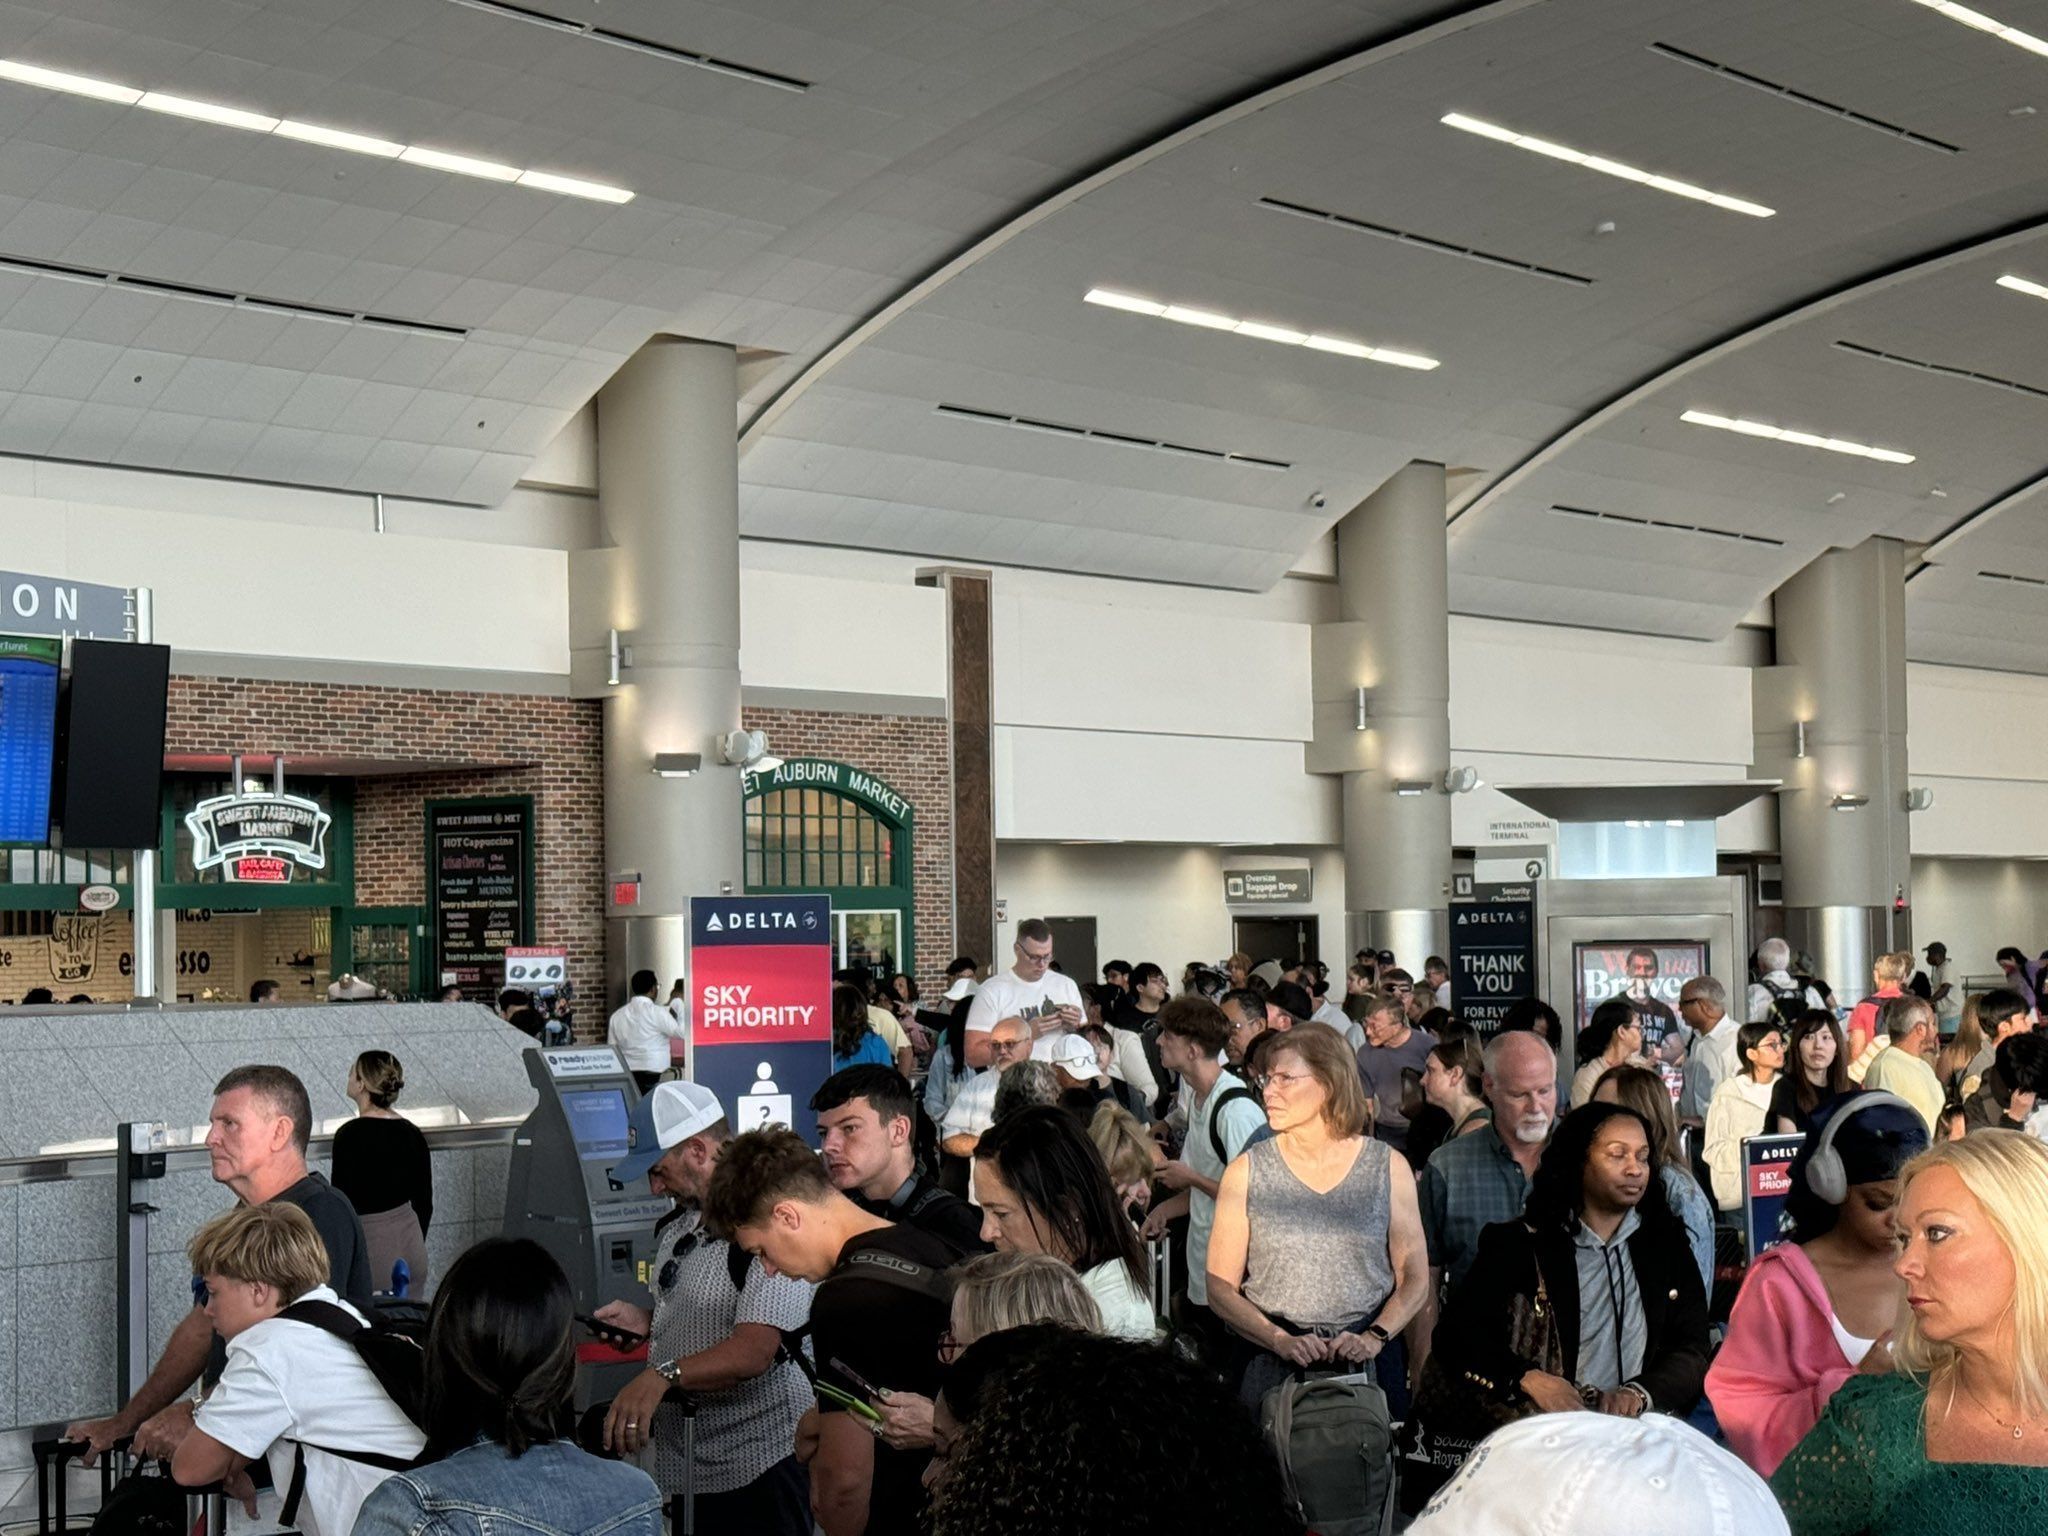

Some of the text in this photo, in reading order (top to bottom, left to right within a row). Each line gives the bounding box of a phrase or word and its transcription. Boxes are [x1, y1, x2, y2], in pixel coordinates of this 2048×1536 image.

[0, 583, 77, 621] ON
[0, 641, 28, 652] rtures
[773, 762, 838, 784] AUBURN
[848, 771, 910, 819] MARKET
[463, 814, 493, 825] AUBURN
[504, 813, 521, 823] MKT
[1489, 821, 1550, 830] INTERNATIONAL
[1491, 831, 1529, 840] TERMINAL
[443, 837, 463, 848] HOT
[1245, 874, 1277, 882] Oversize
[1246, 882, 1298, 892] Baggage Drop
[1502, 886, 1531, 896] Security
[729, 912, 797, 929] DELTA
[1471, 912, 1514, 923] DELTA
[69, 955, 82, 964] TO
[1460, 955, 1525, 973] THANK
[1473, 974, 1513, 992] YOU
[703, 985, 752, 1006] SKY
[704, 1006, 814, 1028] PRIORITY
[1464, 1006, 1512, 1018] FOR FLY
[1471, 1020, 1500, 1031] WITH
[1772, 1147, 1797, 1158] DELT
[1759, 1171, 1778, 1181] SKY
[1760, 1178, 1792, 1190] PRIOR
[596, 1205, 667, 1218] Convert Cash To Card
